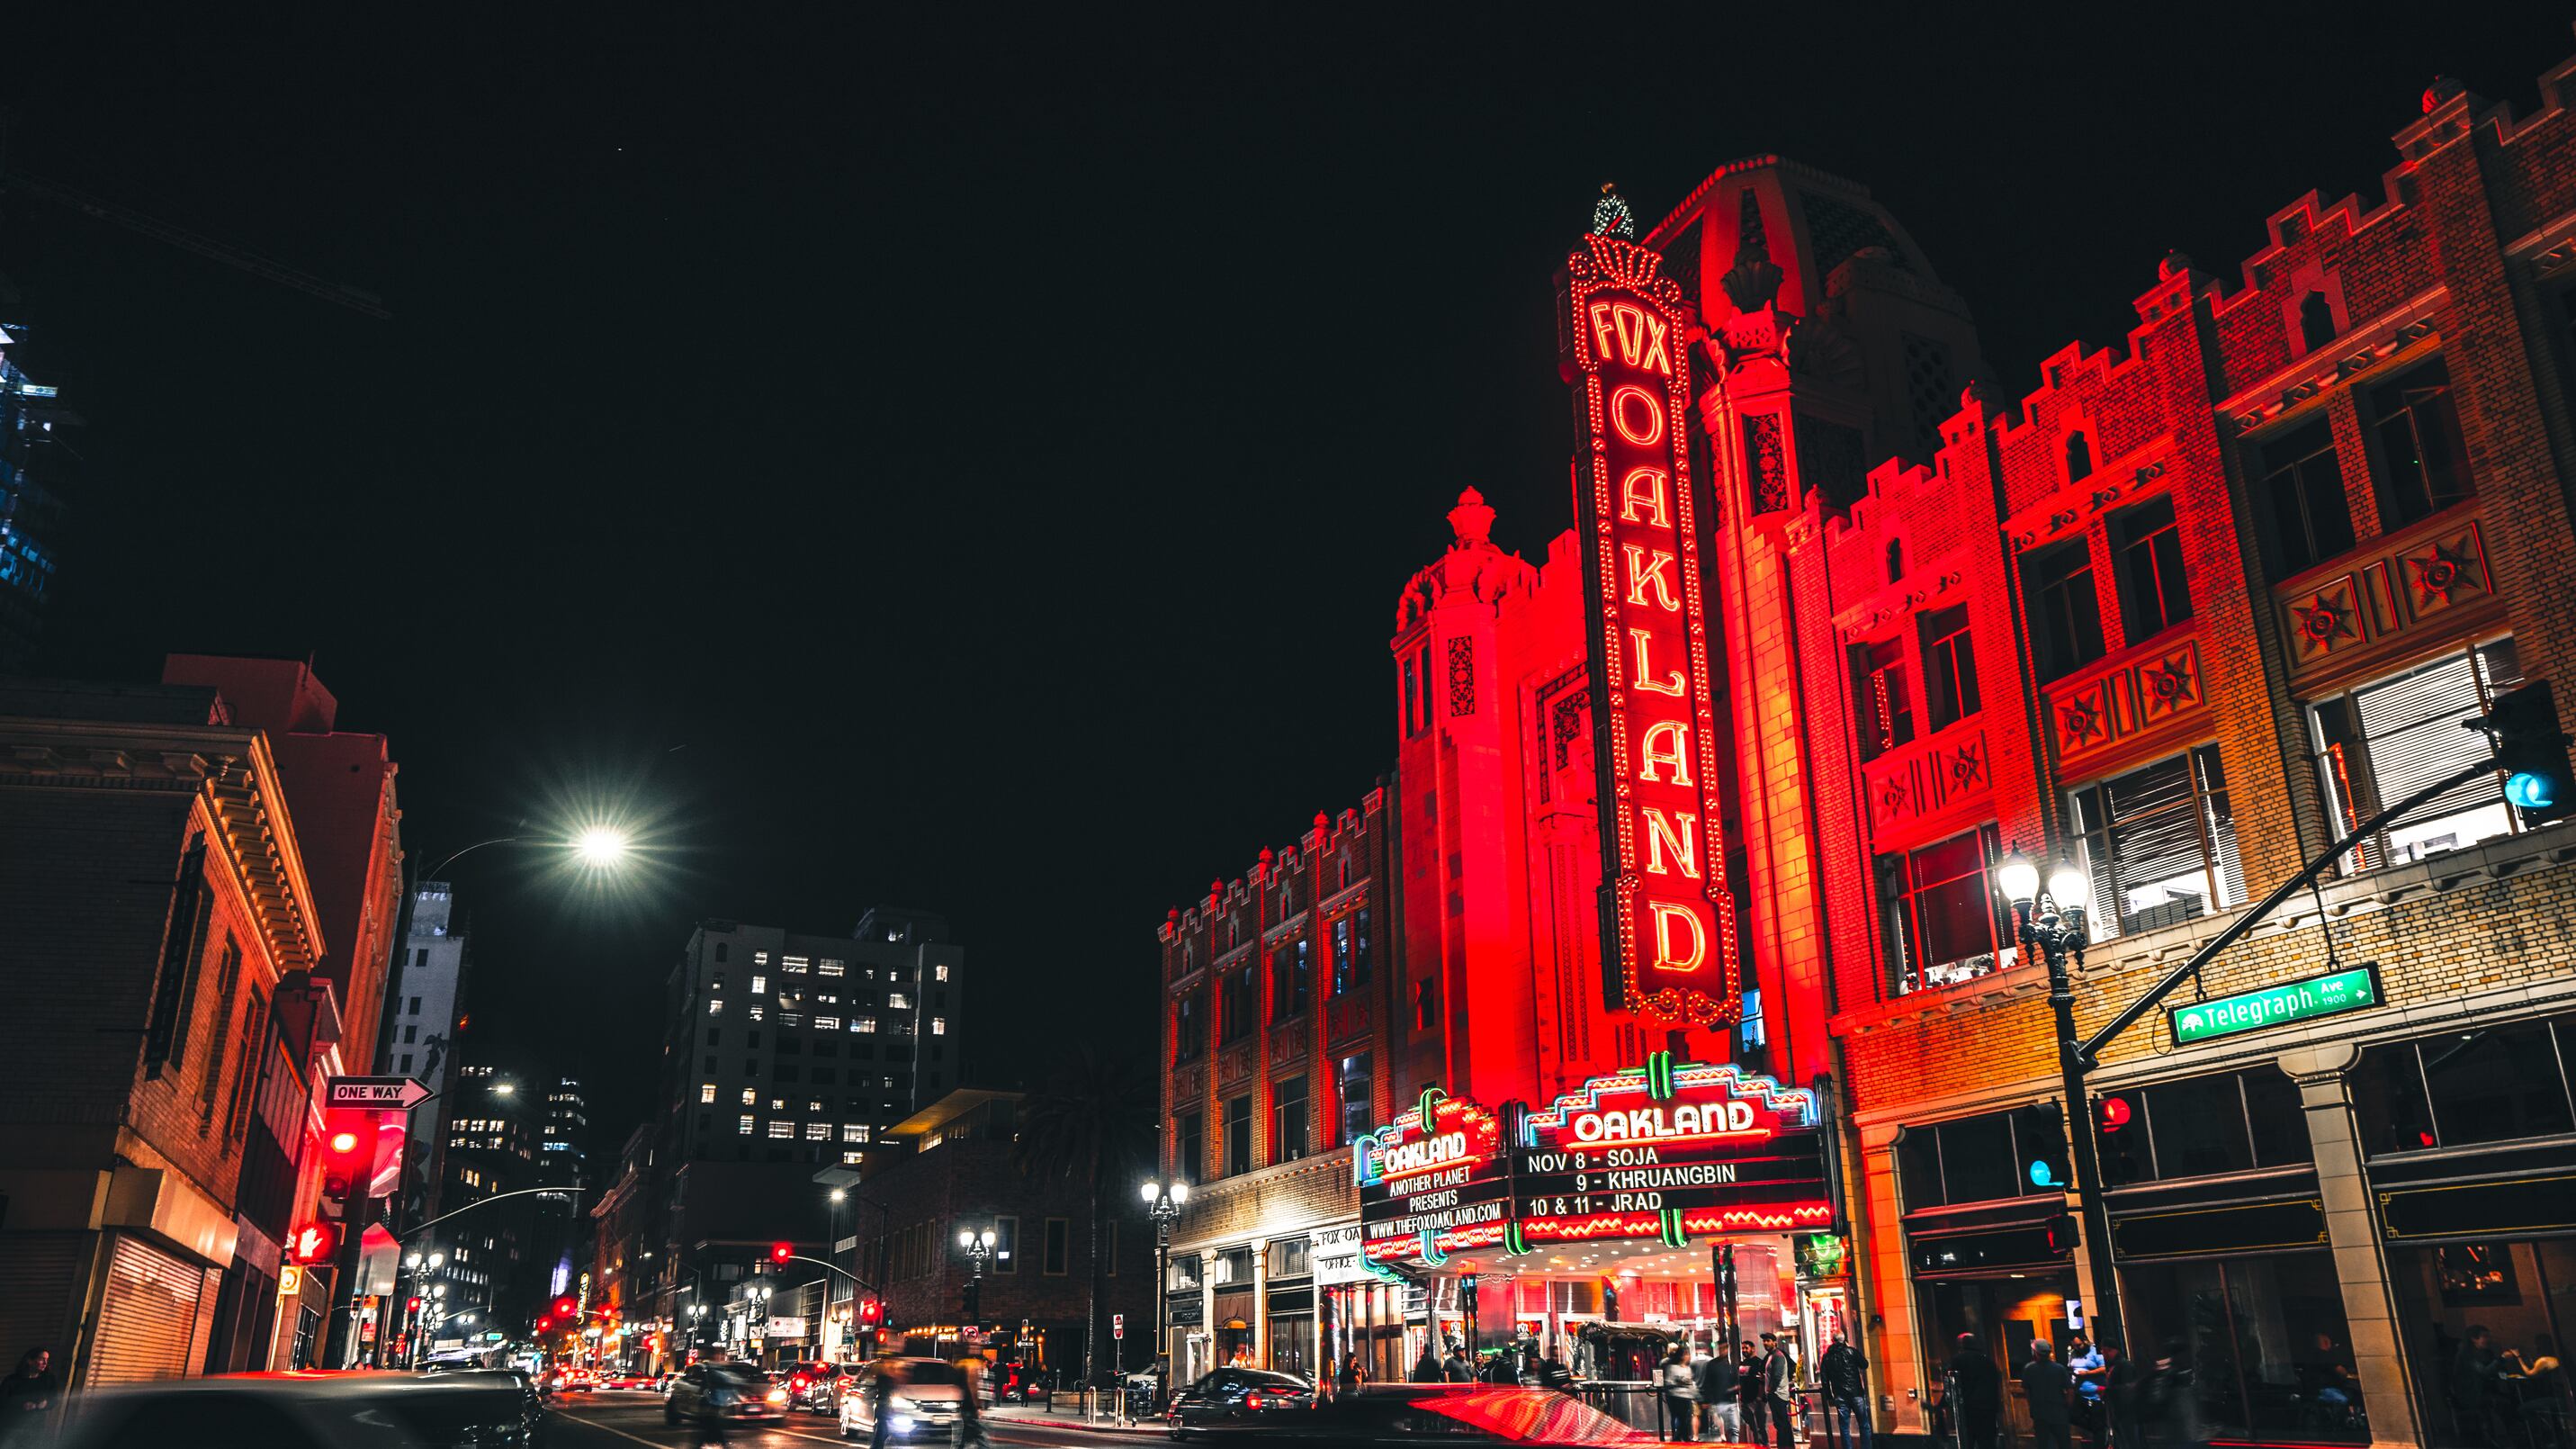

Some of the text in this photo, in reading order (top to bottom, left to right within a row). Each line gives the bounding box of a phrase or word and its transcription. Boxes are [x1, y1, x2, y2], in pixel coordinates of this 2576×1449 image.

[1590, 302, 1672, 376] FOX
[1611, 384, 1706, 972] OAKLAND
[2320, 980, 2344, 994] Ave
[2322, 994, 2347, 1006] 1900
[2204, 987, 2313, 1029] Telegraph
[337, 1086, 403, 1098] ONE WAY
[1575, 1101, 1754, 1142] OAKLAND
[1384, 1131, 1467, 1174] OAKLAND
[1528, 1153, 1567, 1174] NOV
[1575, 1152, 1585, 1169] 8
[1607, 1147, 1659, 1167] SOJA
[1389, 1166, 1471, 1198] ANOTHER PLANET
[1576, 1174, 1587, 1192] 9
[1608, 1164, 1736, 1190] KHRUANGBIN
[1409, 1189, 1458, 1212] PRESENTS
[1530, 1198, 1548, 1217] 10
[1555, 1197, 1567, 1215] &
[1575, 1195, 1590, 1214] 11
[1611, 1192, 1662, 1212] JRAD
[1369, 1202, 1501, 1239] WWW.THEFOXOAKLAND.COM
[1322, 1230, 1340, 1246] FOX
